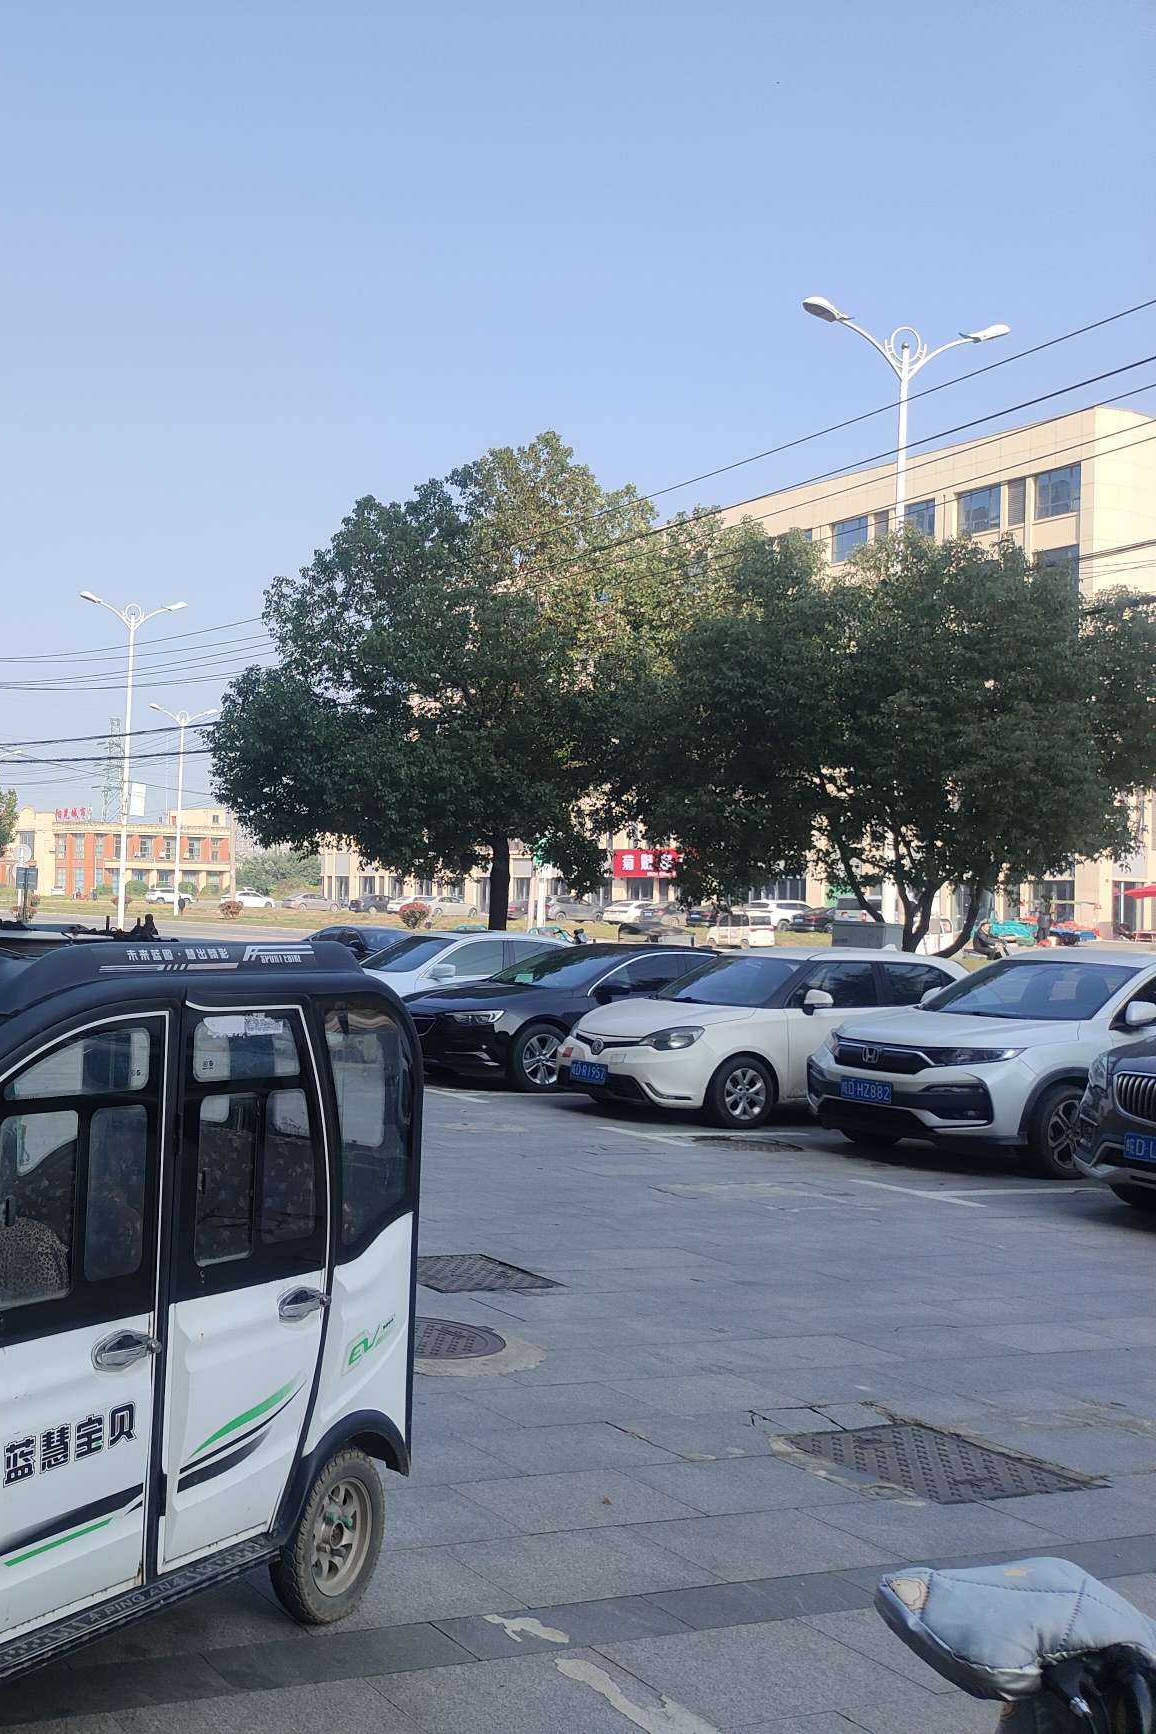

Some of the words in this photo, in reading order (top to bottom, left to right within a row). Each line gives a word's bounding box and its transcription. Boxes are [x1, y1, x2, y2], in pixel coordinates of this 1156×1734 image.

[4, 1402, 137, 1488] 蓝慧宝贝
[103, 1593, 146, 1616] PING
[149, 1582, 173, 1597] AN
